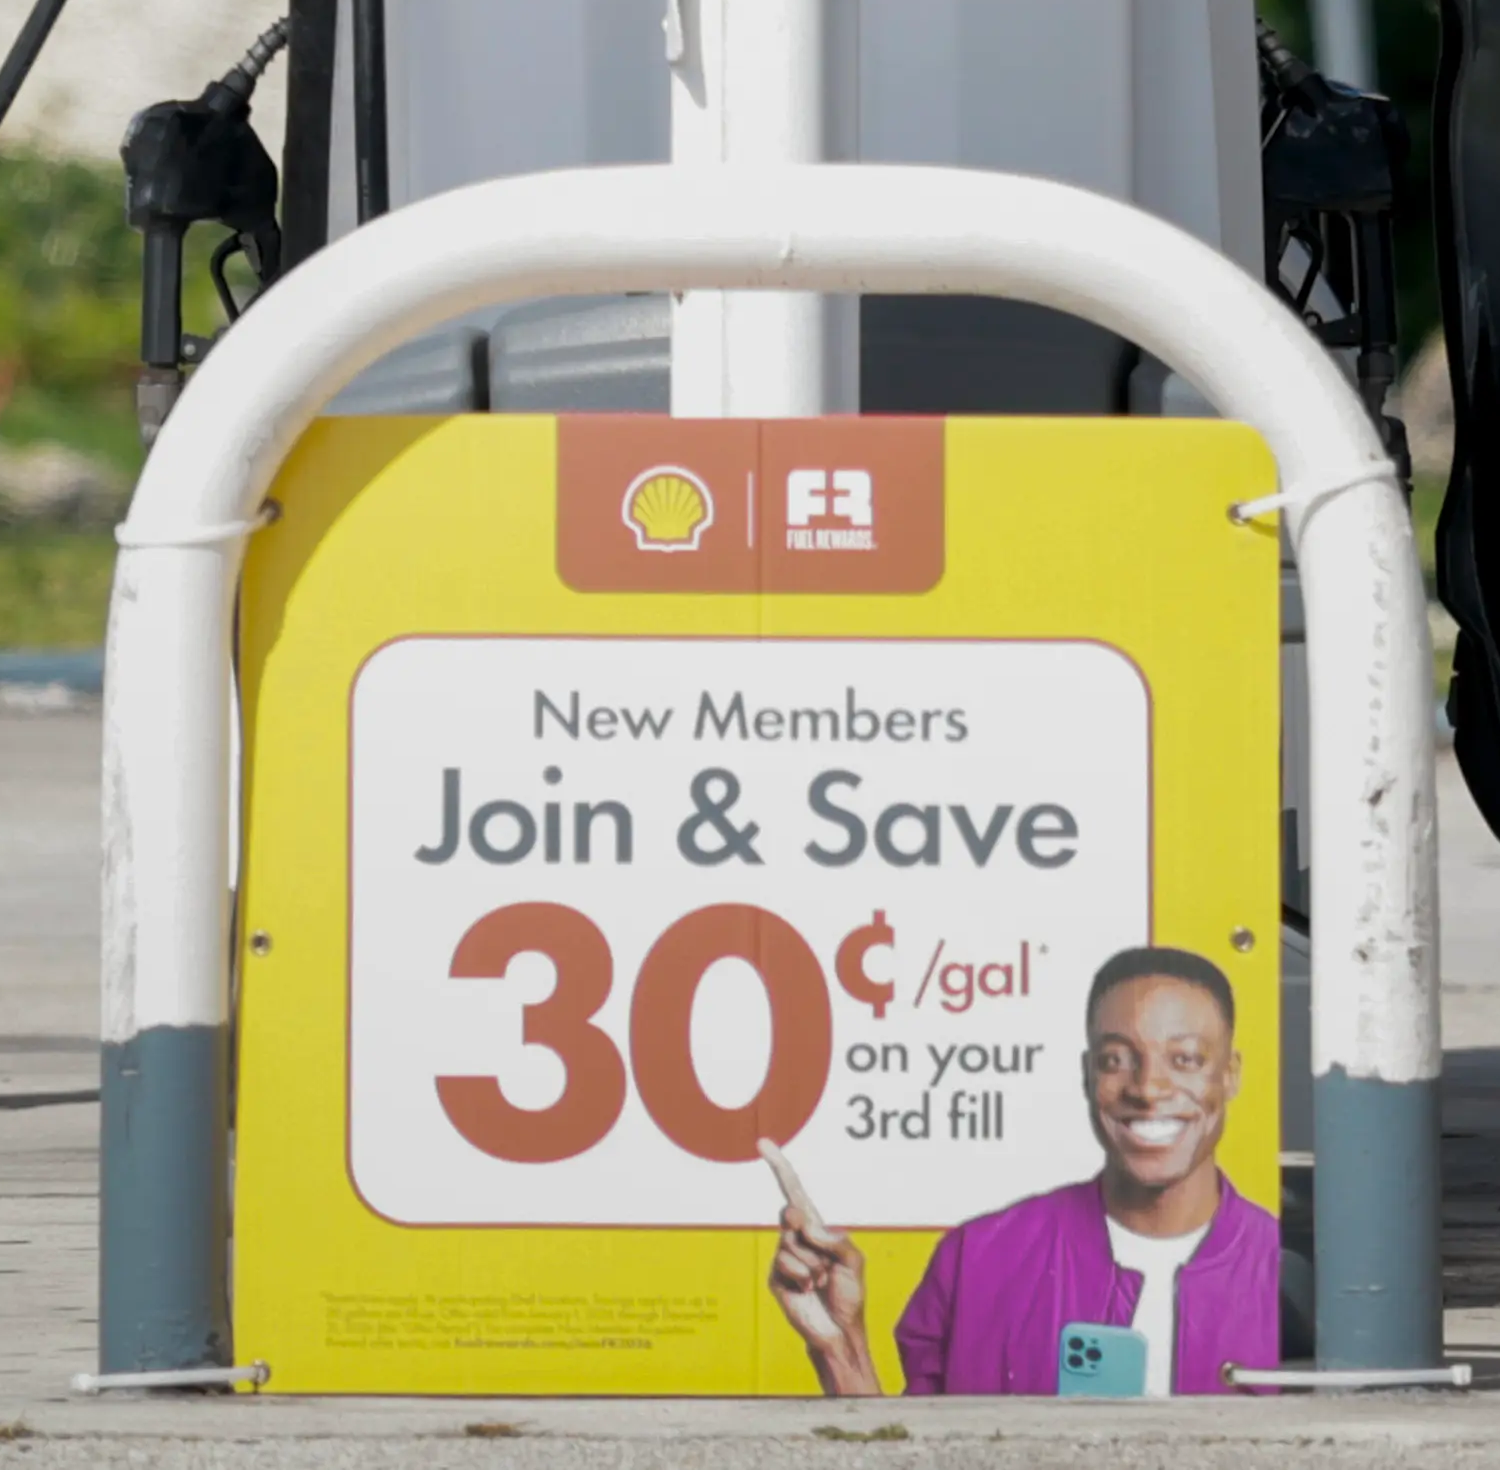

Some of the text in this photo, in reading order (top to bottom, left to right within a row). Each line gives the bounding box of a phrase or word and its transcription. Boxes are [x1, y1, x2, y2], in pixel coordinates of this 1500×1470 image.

[533, 686, 969, 743] New Members
[414, 764, 1080, 870] Join & Save
[845, 1042, 1044, 1087] on your
[845, 1089, 1004, 1141] 3rd fill
